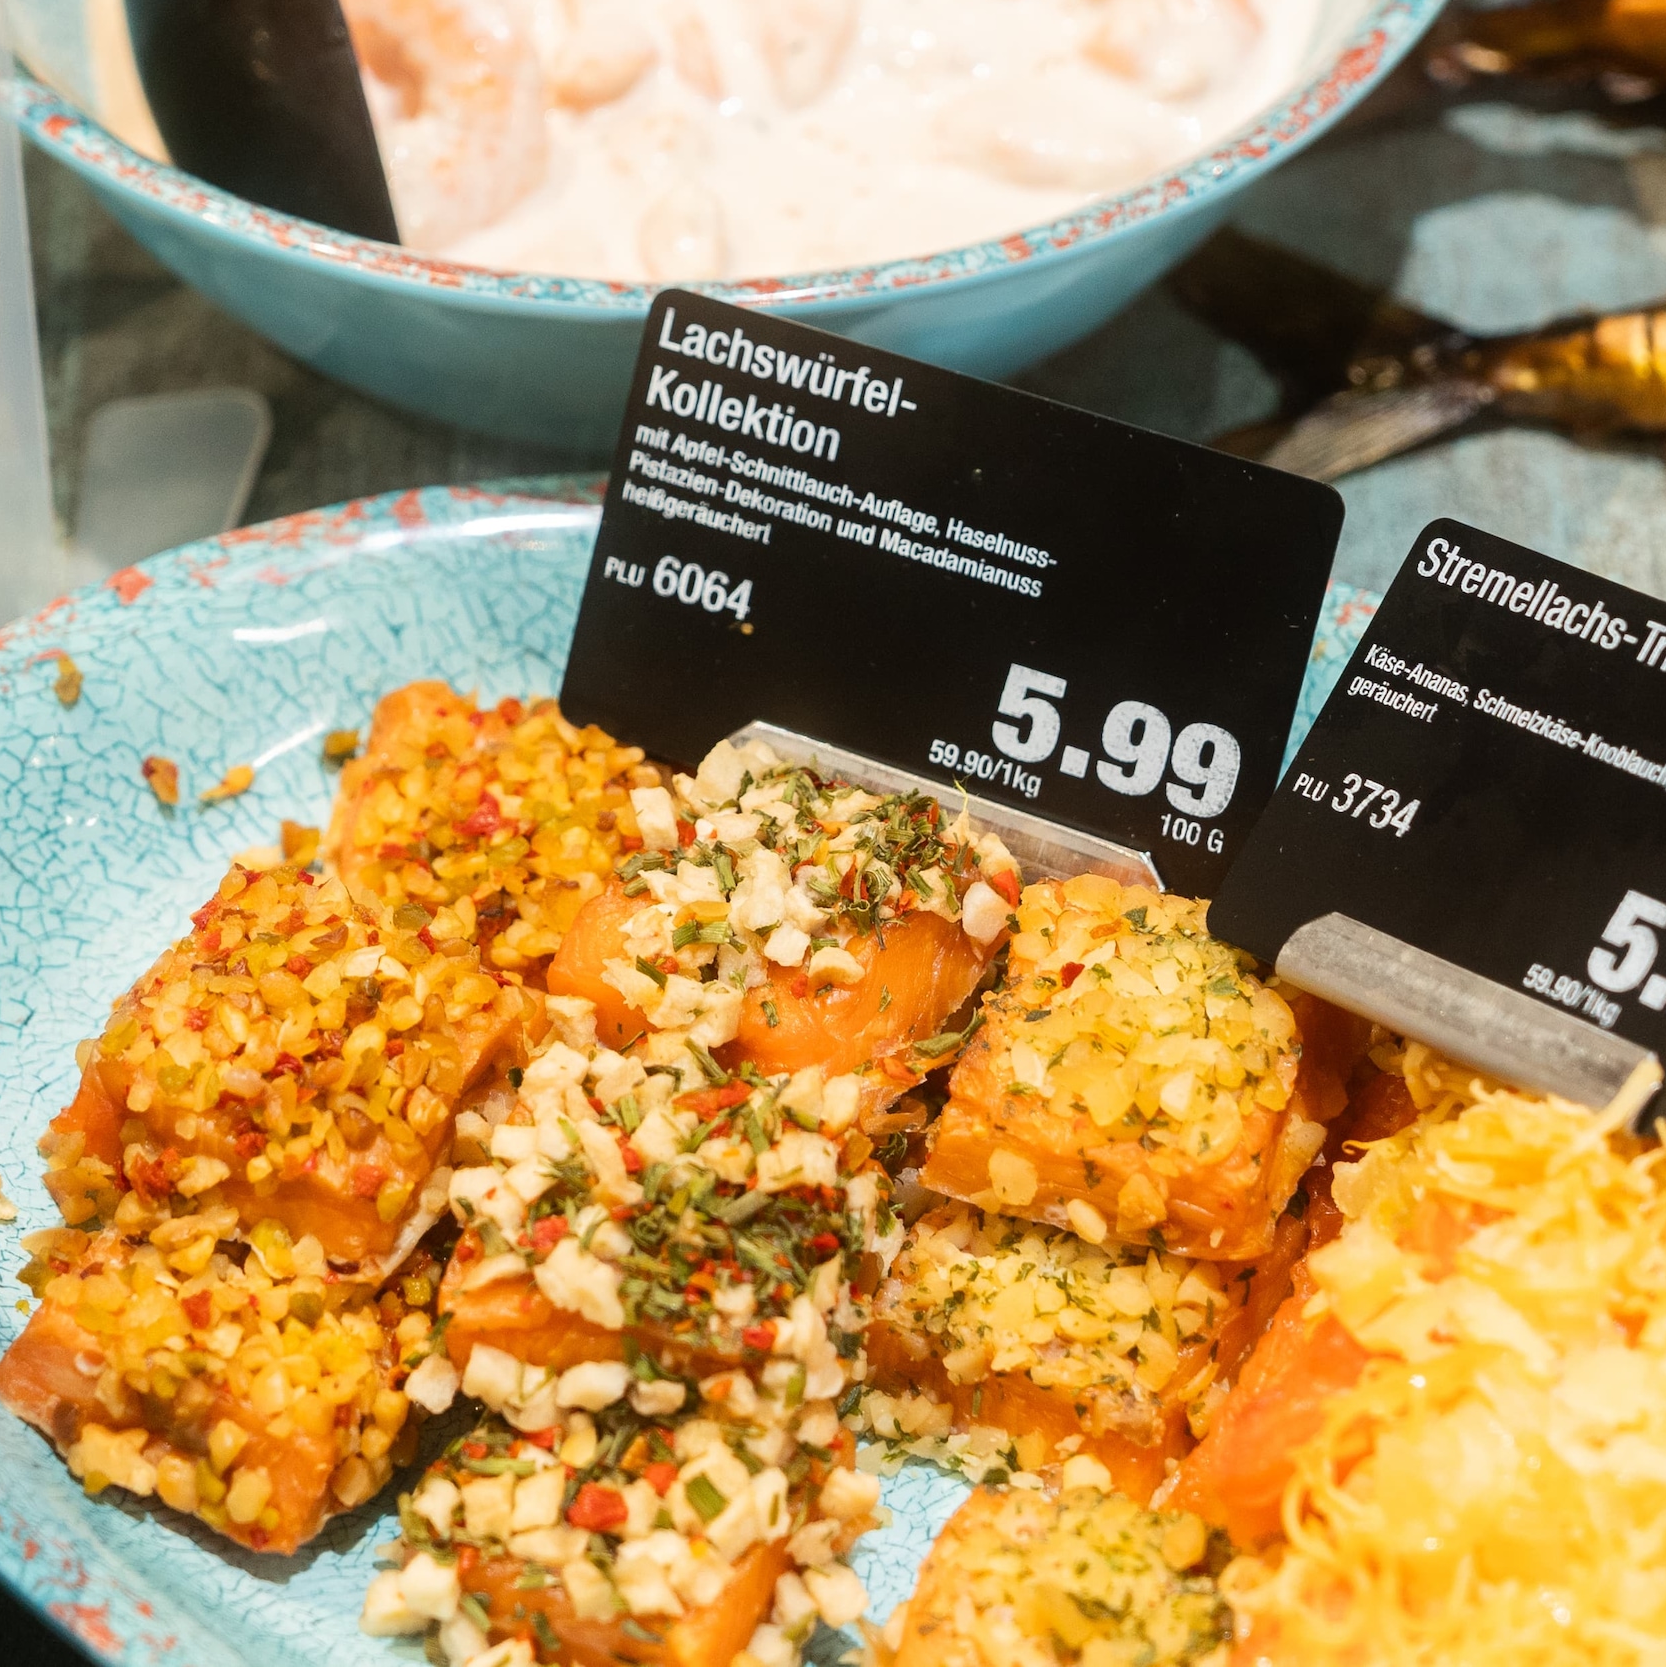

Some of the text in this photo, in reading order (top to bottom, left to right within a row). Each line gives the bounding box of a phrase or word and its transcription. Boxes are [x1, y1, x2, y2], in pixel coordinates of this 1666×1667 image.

[658, 306, 917, 417] Lachswürfel-
[645, 364, 841, 462] Kollektion
[621, 479, 772, 545] heißgeräuchert
[628, 449, 1043, 598] Pistazien-Dekoration und Macadamianuss
[634, 424, 1058, 569] mit Apfel-Schnittlauch-Auflage, Haselnuss-
[603, 555, 753, 621] PLU 6064
[1346, 675, 1439, 723] geräuchert
[1363, 643, 1470, 707] Käse-Ananas,
[928, 738, 1042, 799] 59.90/1kg
[990, 663, 1242, 818] 5.99
[1160, 813, 1225, 854] 100 G
[1292, 772, 1421, 838] PLU 3734
[1522, 962, 1622, 1029] 59.90/1kg
